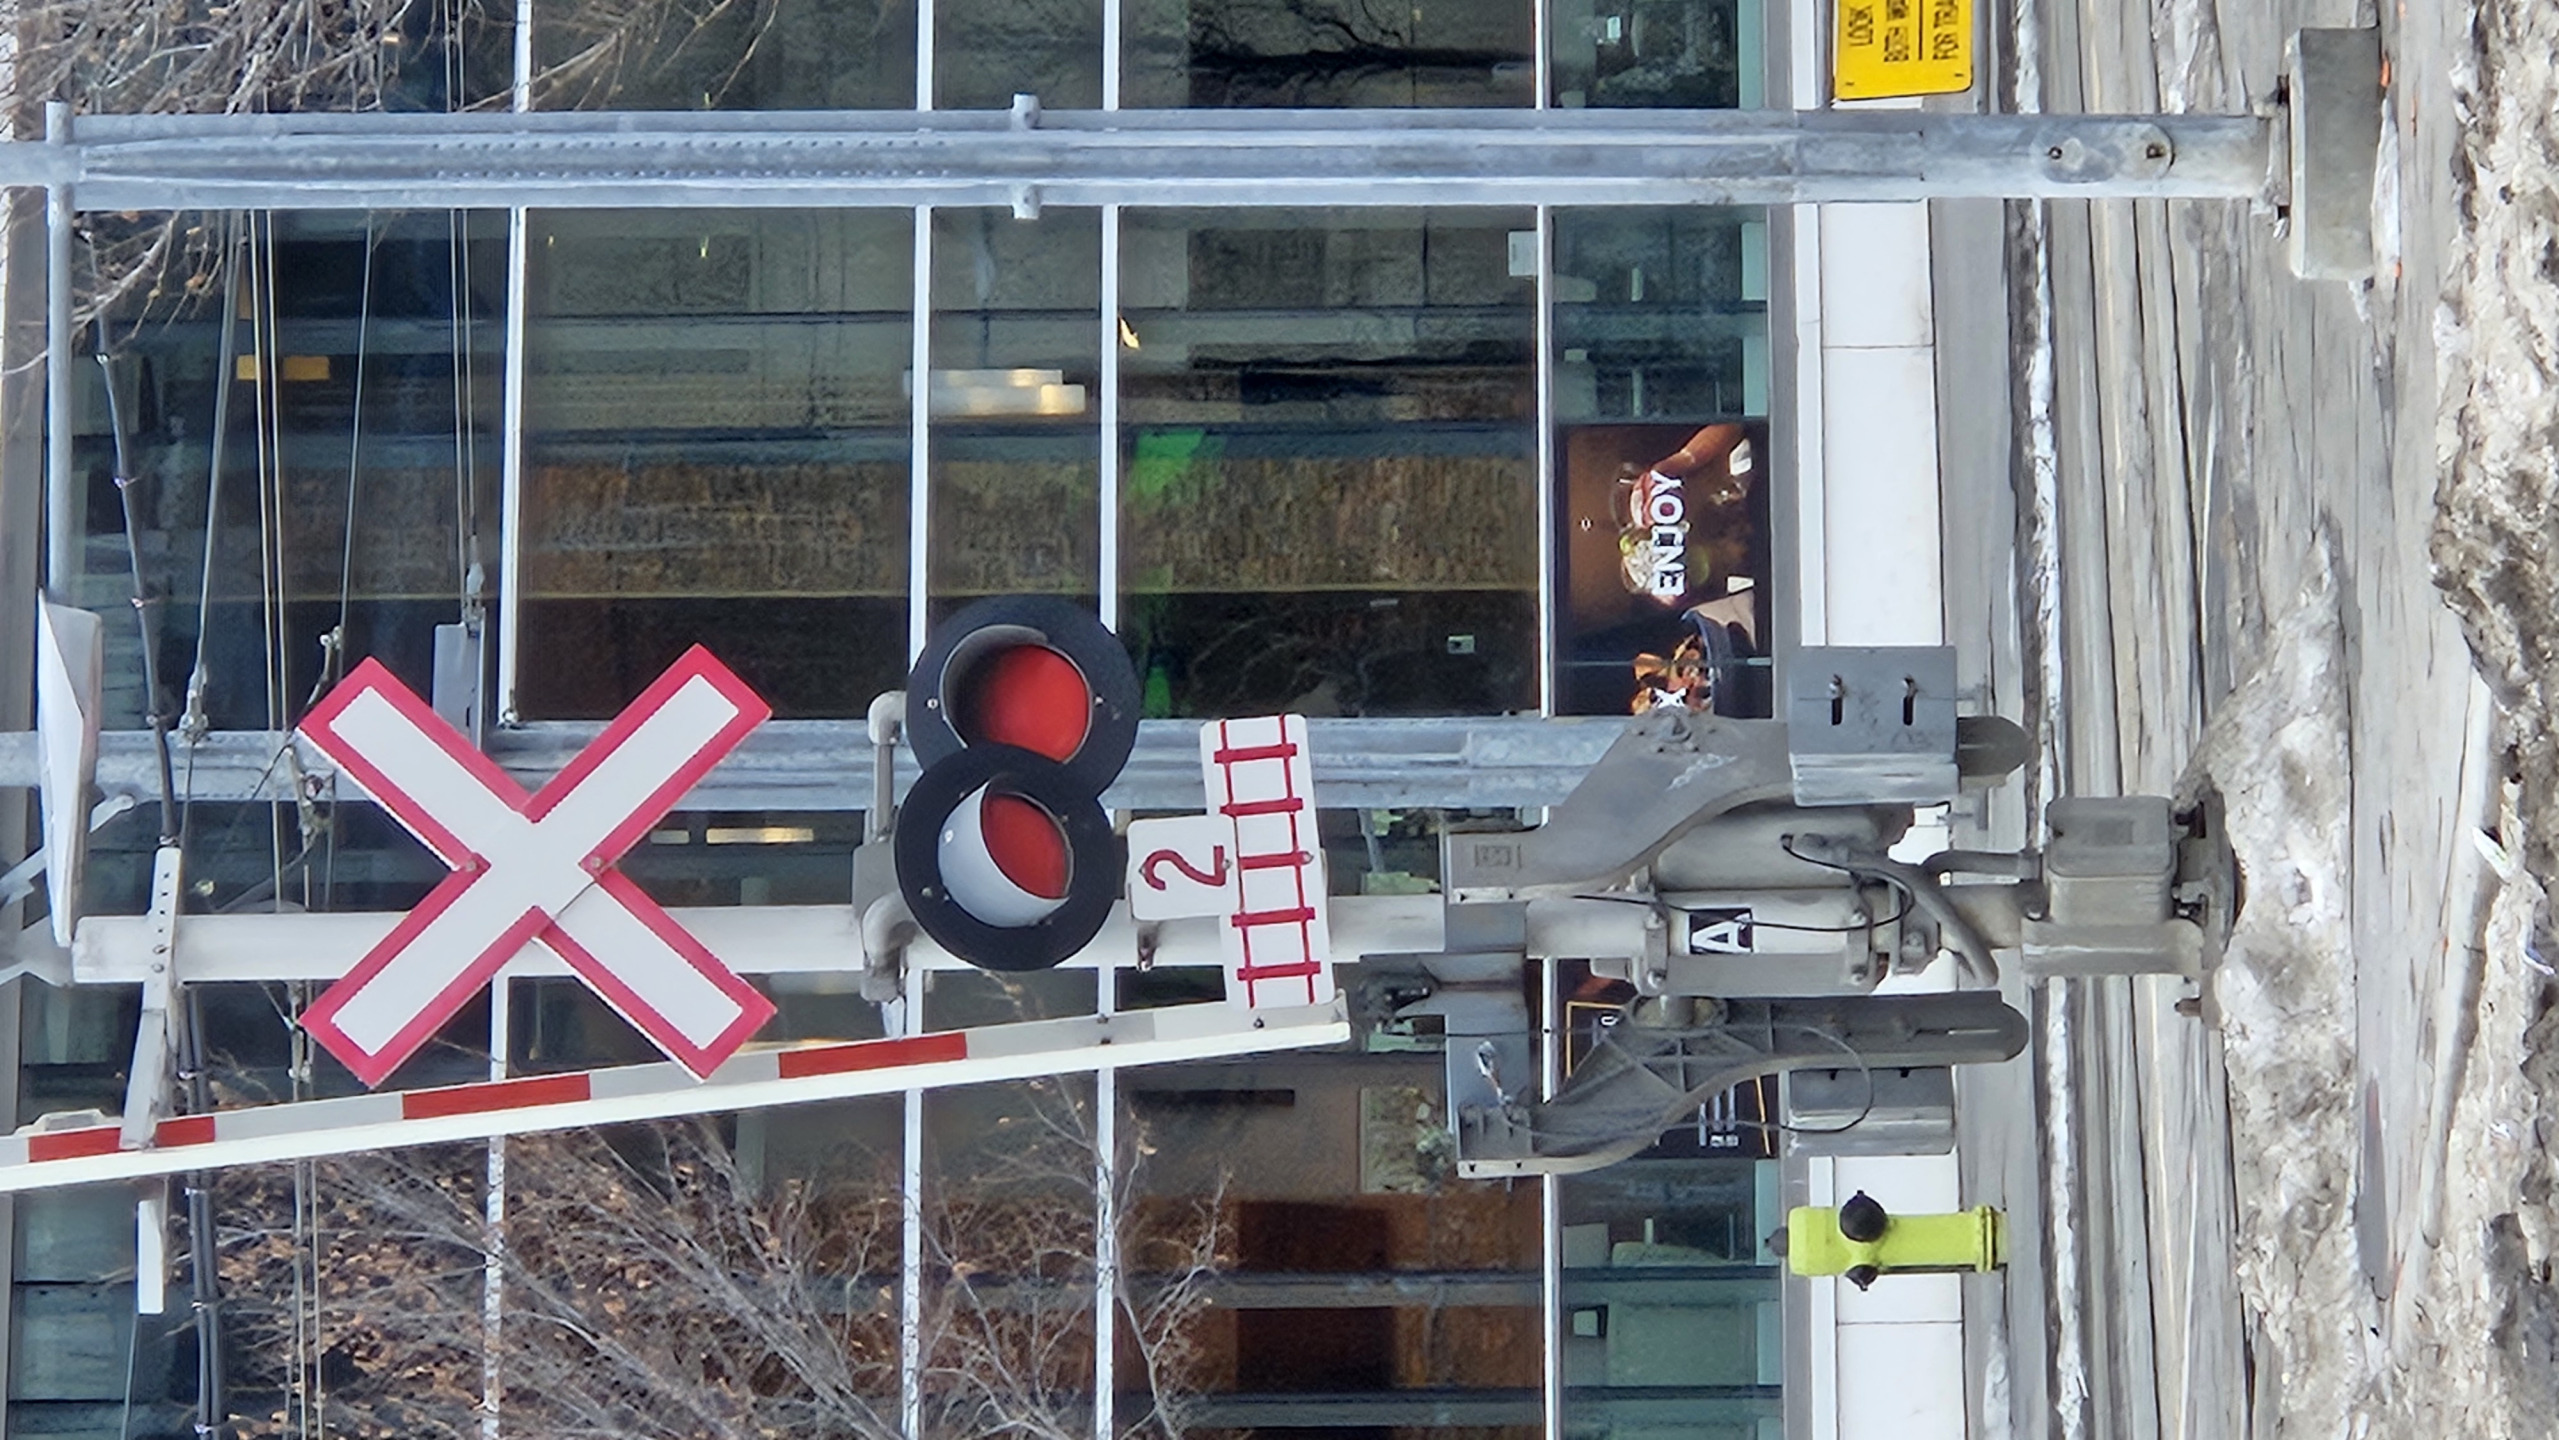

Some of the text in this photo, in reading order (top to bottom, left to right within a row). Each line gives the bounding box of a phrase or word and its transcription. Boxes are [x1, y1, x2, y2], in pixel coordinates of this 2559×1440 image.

[1847, 5, 1874, 46] LOOK
[1884, 27, 1910, 62] BOTH
[1933, 31, 1959, 60] FOR
[1650, 469, 1686, 597] ENJOY
[1144, 845, 1226, 891] 2
[1691, 912, 1752, 953] A
